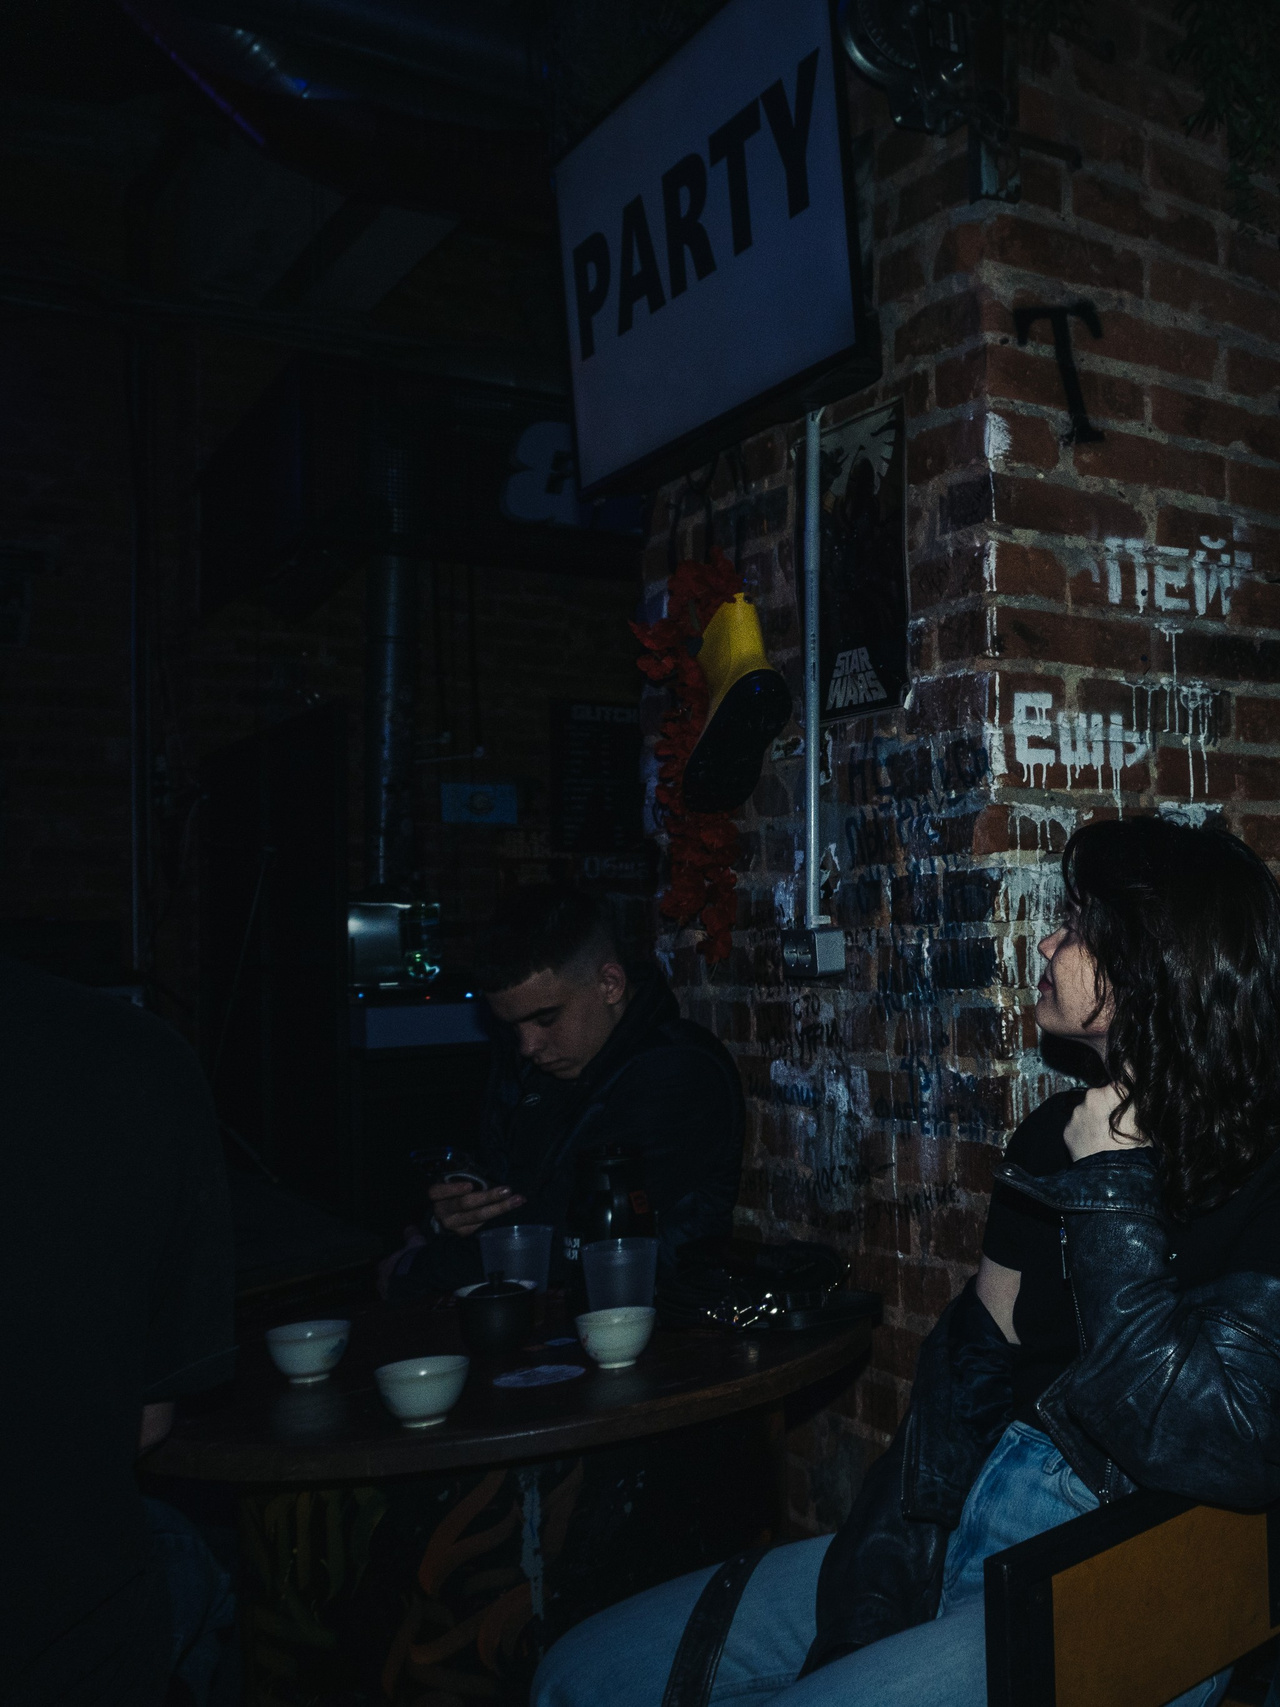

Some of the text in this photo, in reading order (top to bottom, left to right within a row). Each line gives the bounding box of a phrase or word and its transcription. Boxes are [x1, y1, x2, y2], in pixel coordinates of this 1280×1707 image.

[572, 46, 819, 362] PARTY
[832, 646, 873, 679] STAR
[826, 671, 888, 711] WARS
